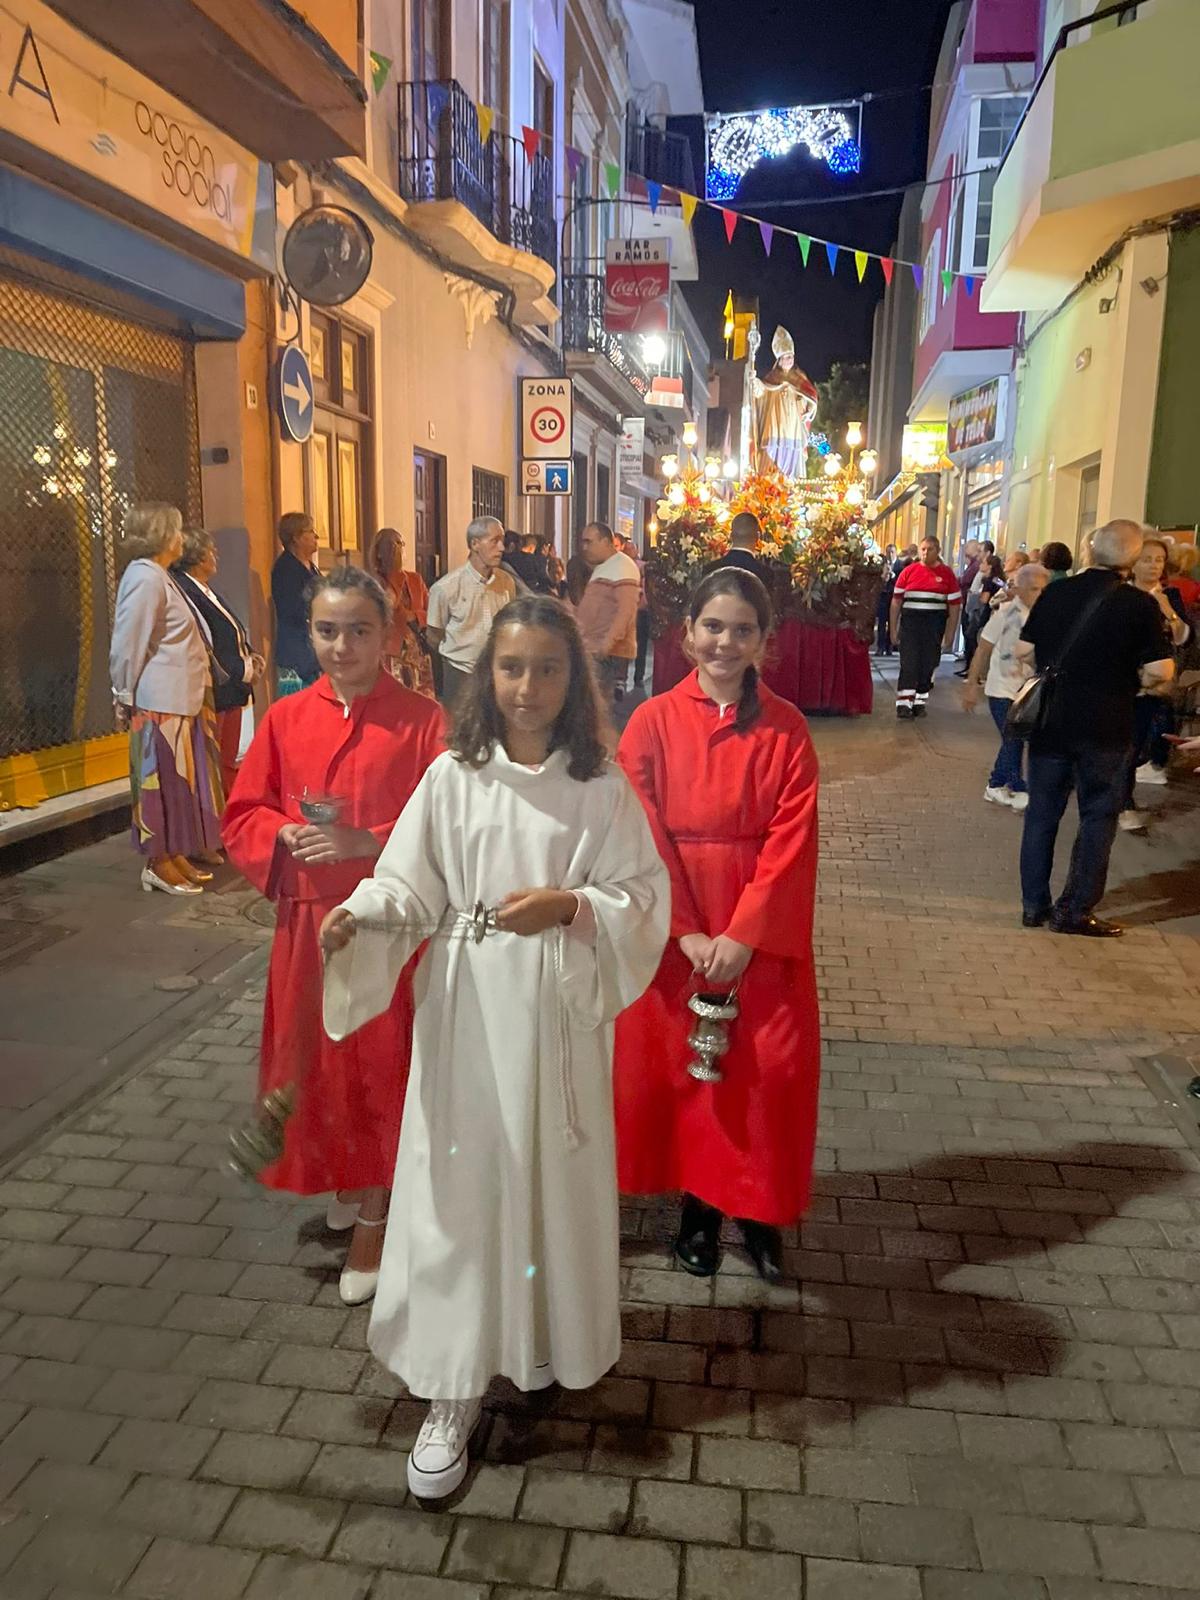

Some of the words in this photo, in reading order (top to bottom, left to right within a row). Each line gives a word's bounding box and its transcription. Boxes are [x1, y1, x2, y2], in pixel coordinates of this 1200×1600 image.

[8, 23, 60, 125] A
[161, 150, 232, 223] social
[625, 240, 650, 250] BAR
[615, 250, 660, 261] RAMOS
[528, 385, 566, 396] ZONA
[538, 418, 558, 431] 30
